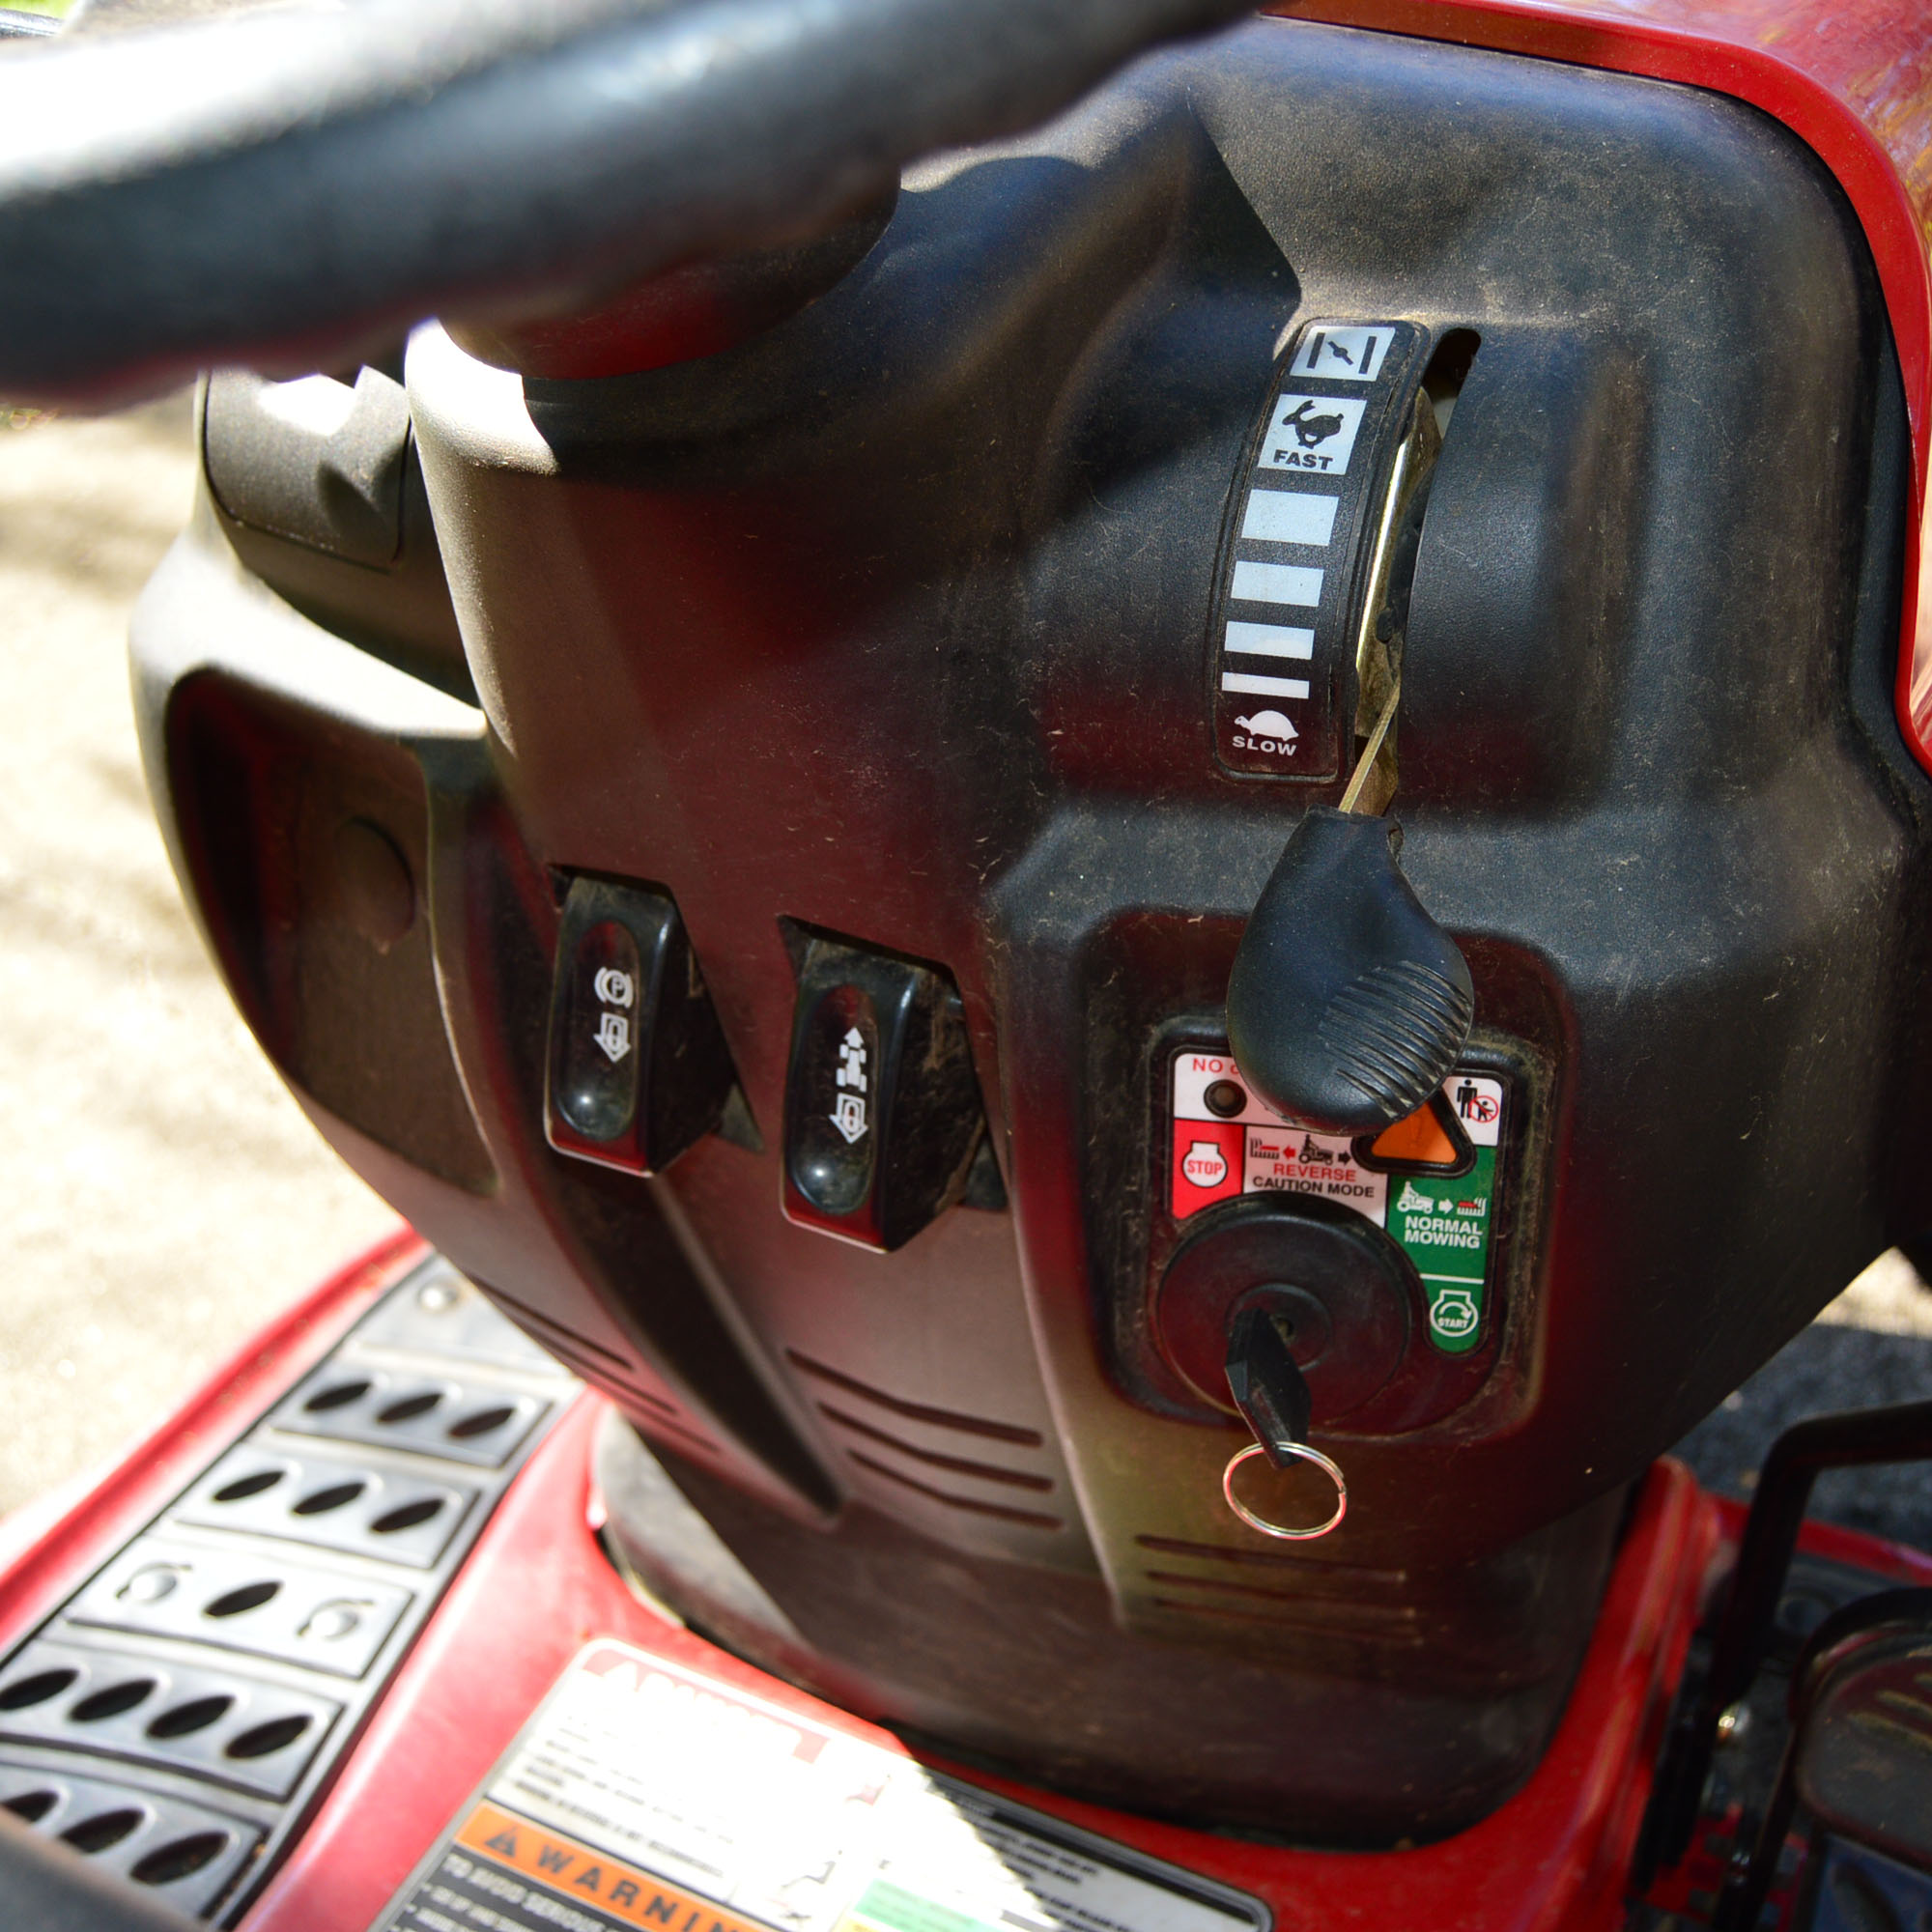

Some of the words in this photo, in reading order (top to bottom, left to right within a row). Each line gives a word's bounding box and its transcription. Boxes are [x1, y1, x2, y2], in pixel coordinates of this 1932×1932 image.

[1272, 449, 1334, 471] FAST
[1232, 735, 1297, 757] SLOW
[1192, 1058, 1223, 1073] NO
[1186, 1156, 1224, 1176] STOP
[1272, 1162, 1357, 1183] REVERSE
[1252, 1175, 1323, 1195] CAUTION
[1327, 1182, 1376, 1199] MODE
[1405, 1215, 1484, 1236] NORMAL
[1404, 1230, 1481, 1250] MOWING
[1437, 1317, 1469, 1329] START
